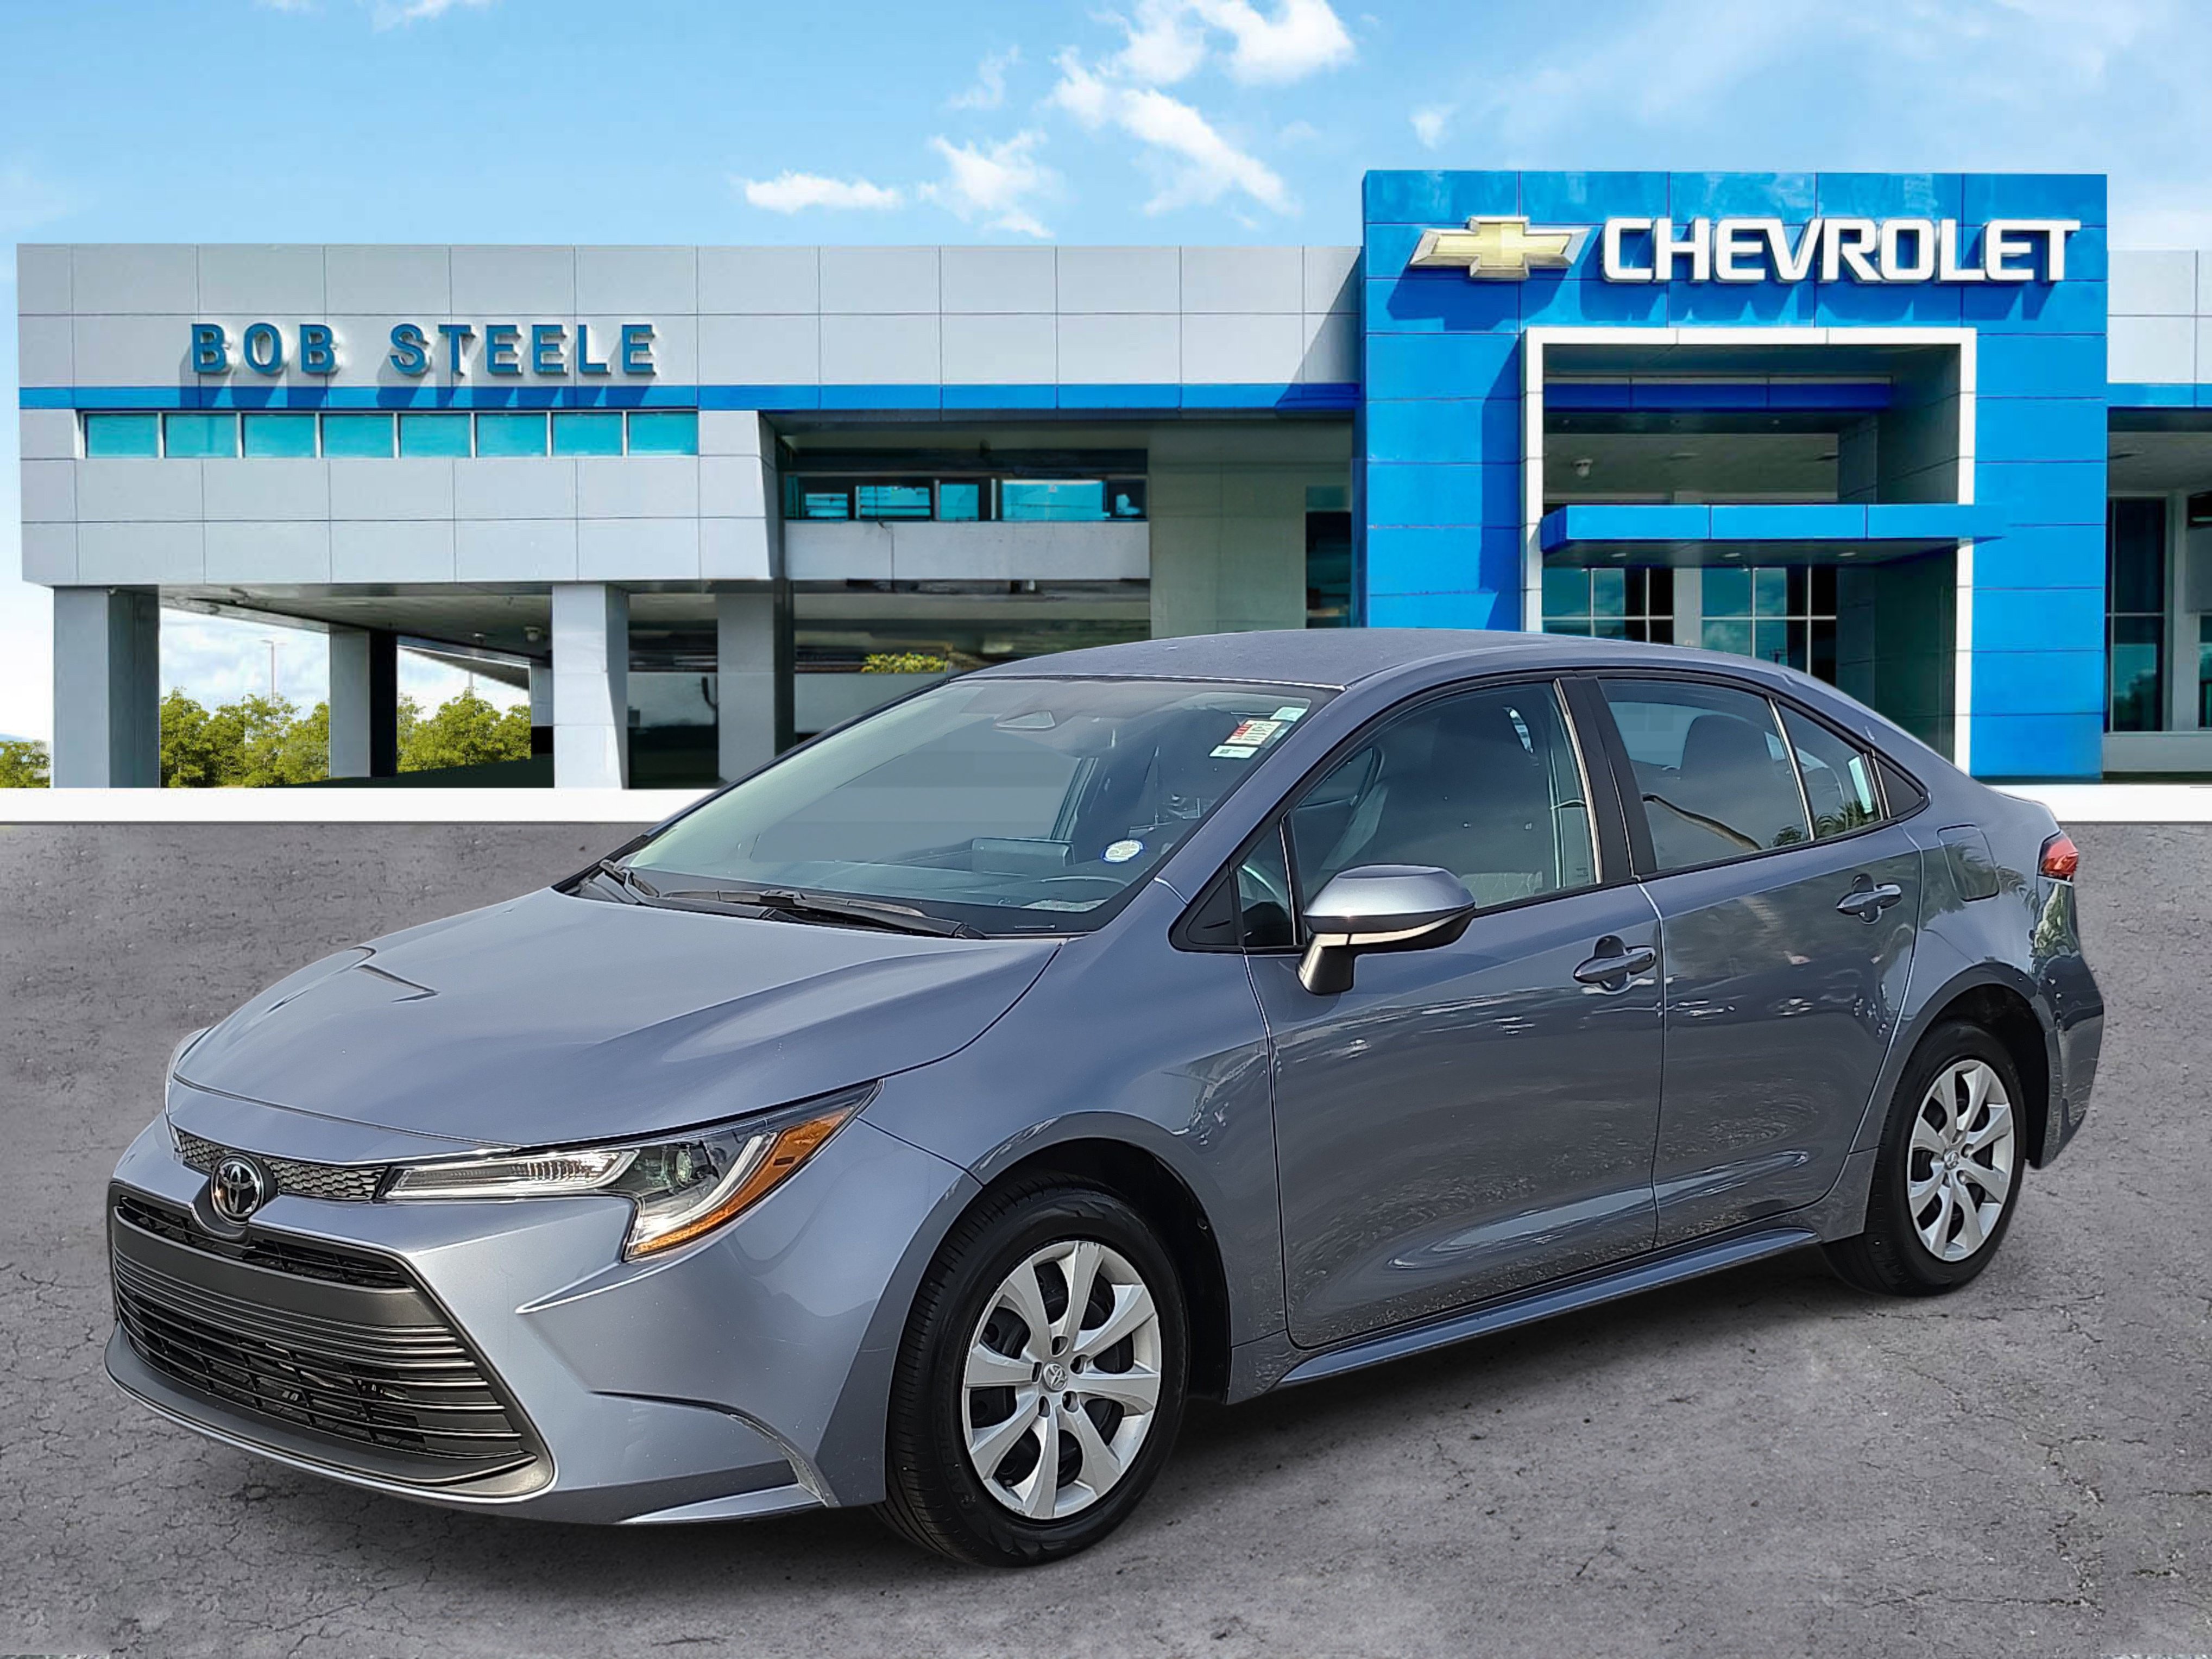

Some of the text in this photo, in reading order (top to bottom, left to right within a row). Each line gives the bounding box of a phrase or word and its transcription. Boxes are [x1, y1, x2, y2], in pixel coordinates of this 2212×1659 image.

[1604, 218, 2081, 282] CHEVROLET
[192, 323, 655, 375] BOB STEELE
